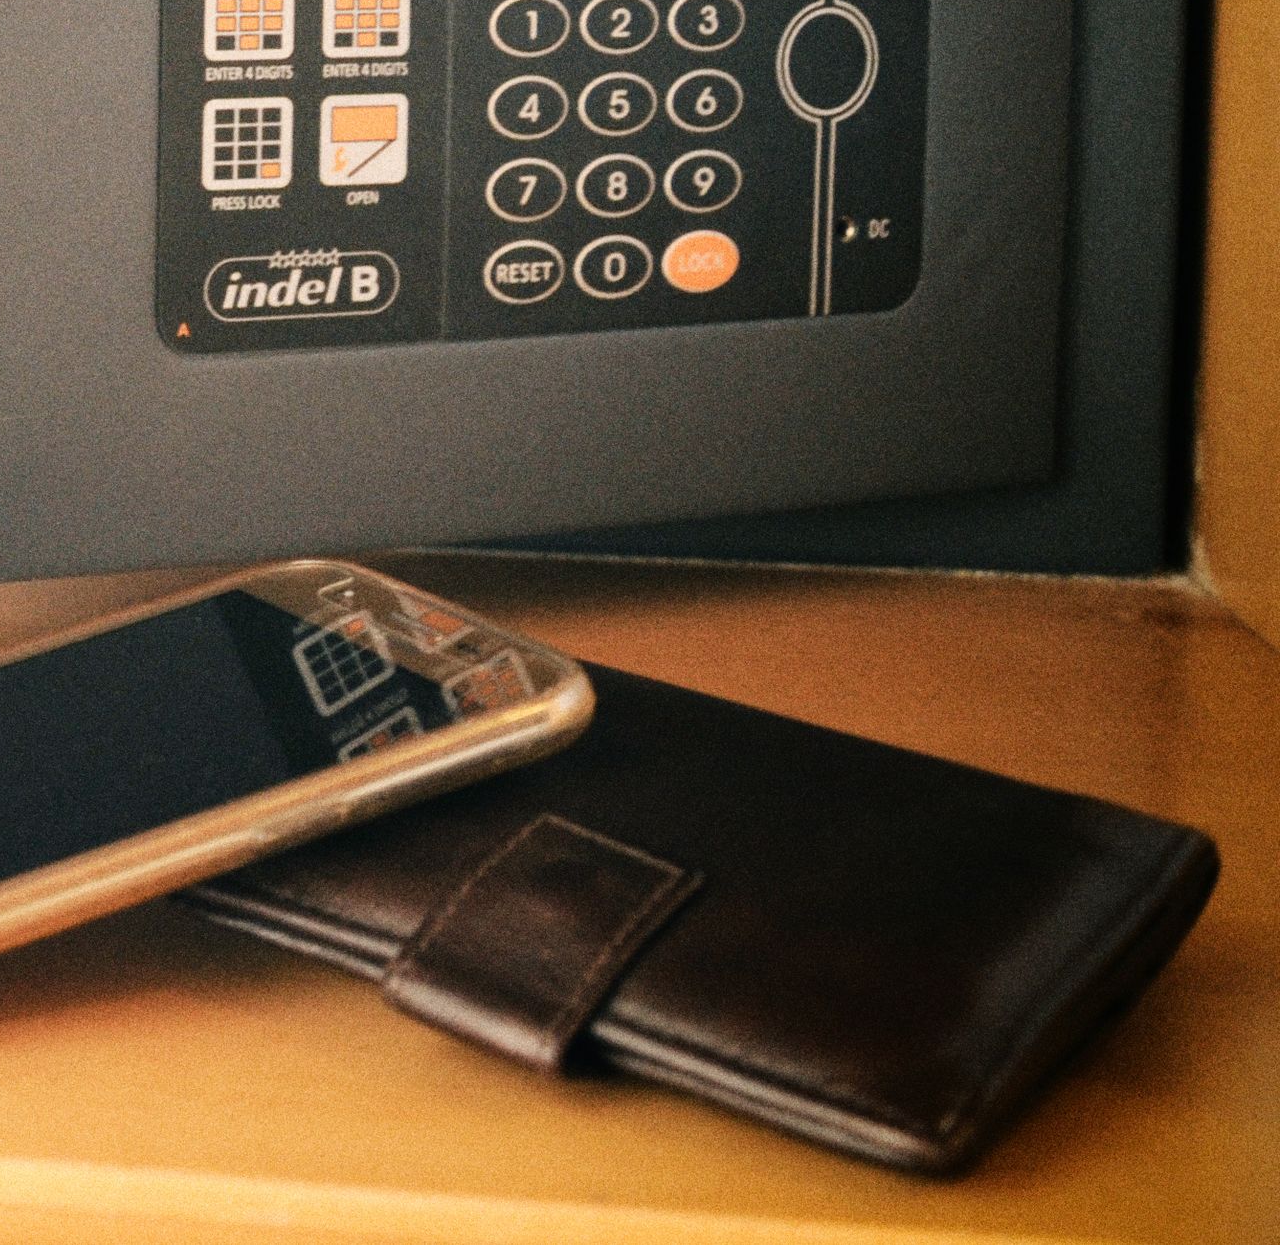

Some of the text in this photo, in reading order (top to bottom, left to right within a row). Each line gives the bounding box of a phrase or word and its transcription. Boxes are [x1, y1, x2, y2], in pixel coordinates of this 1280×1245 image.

[527, 11, 538, 40] 1
[611, 8, 630, 38] 2
[699, 5, 718, 35] 3
[206, 64, 293, 81] ENTER 4 DIGITS
[323, 61, 408, 78] ENTER 4 DIGITS
[520, 95, 540, 123] 4
[609, 90, 629, 119] 5
[697, 87, 716, 116] 6
[519, 176, 538, 205] 7
[607, 172, 627, 201] 8
[694, 167, 714, 196] 9
[212, 193, 280, 210] PRESS LOCK
[347, 191, 379, 206] OPEN
[496, 262, 554, 285] RESET
[604, 253, 626, 282] 0
[222, 266, 380, 309] indel B
